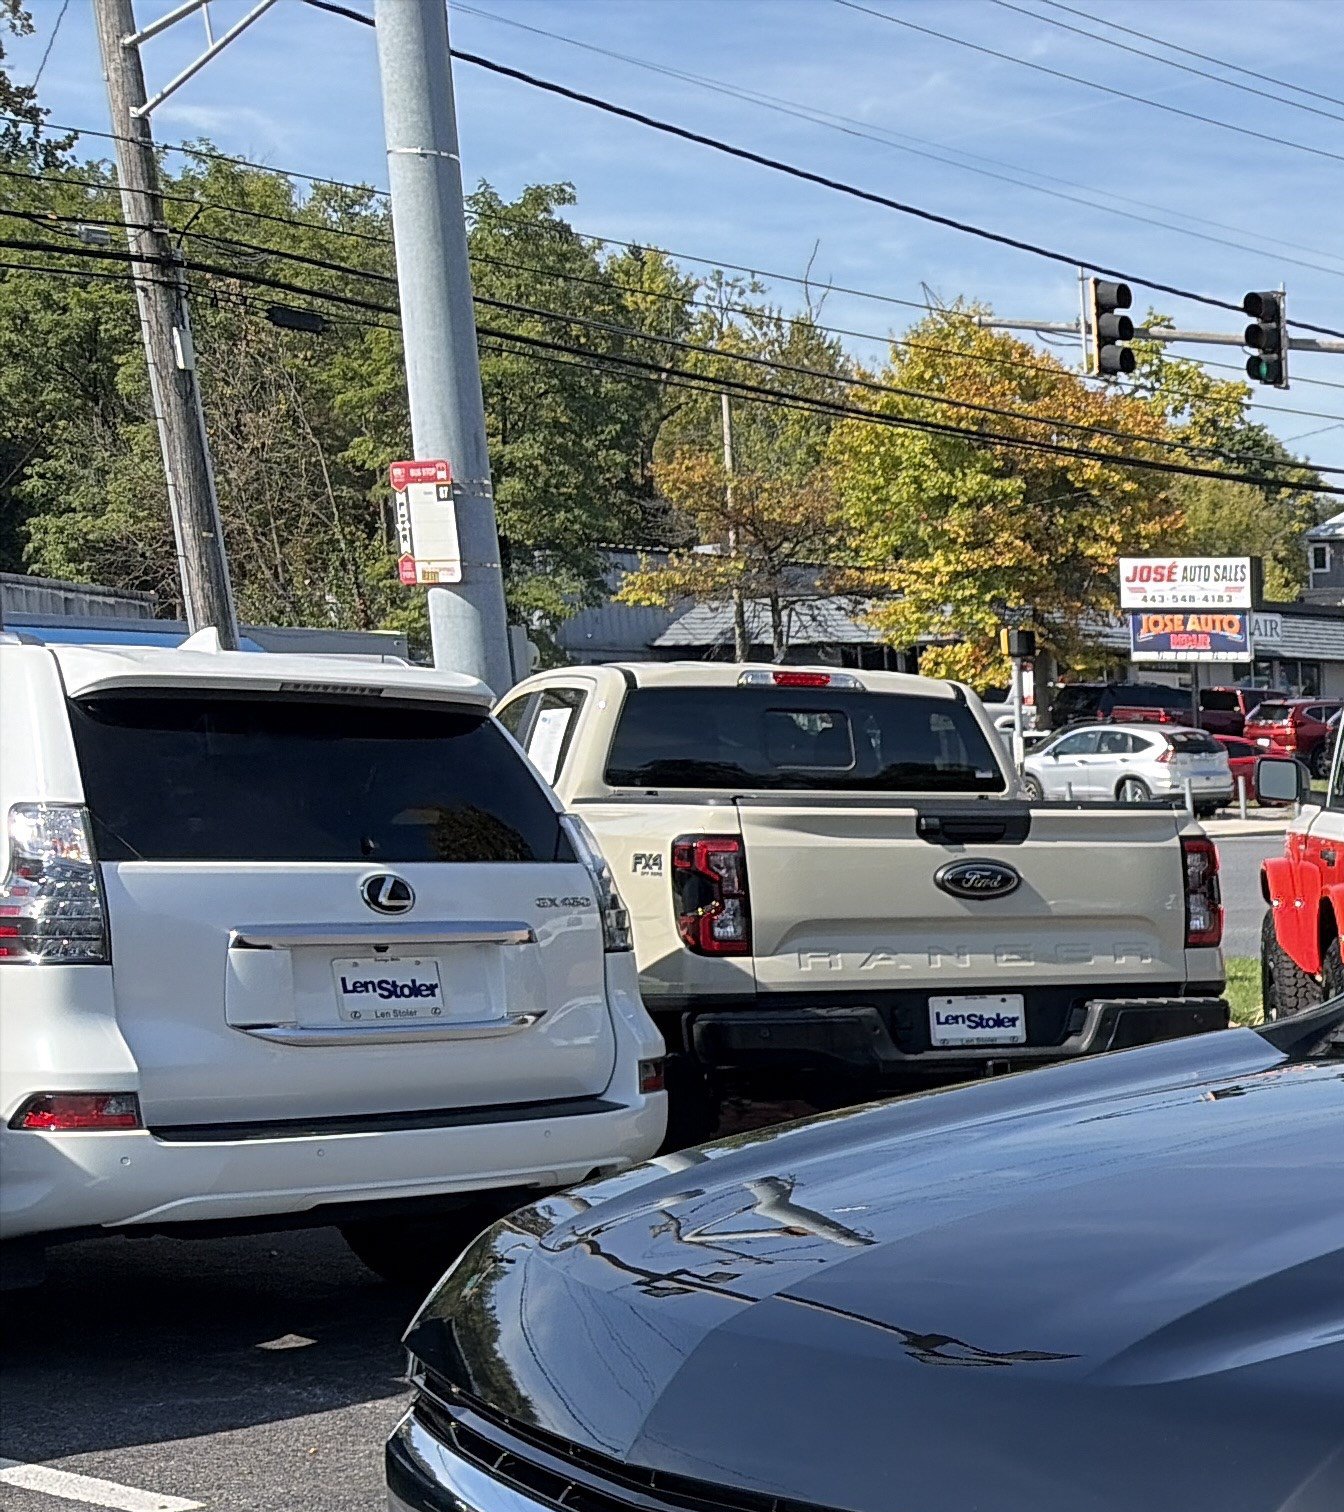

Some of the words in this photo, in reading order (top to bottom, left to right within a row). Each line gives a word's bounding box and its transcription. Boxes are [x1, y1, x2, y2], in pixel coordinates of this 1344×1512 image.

[1125, 561, 1179, 583] JOSÉ
[1181, 565, 1210, 582] AUTO
[1214, 564, 1247, 582] SALES
[1140, 614, 1184, 635] JOSE
[1186, 614, 1240, 636] AUTO
[632, 853, 663, 873] FX4
[962, 870, 1003, 888] Ford
[799, 941, 1153, 970] RANGER
